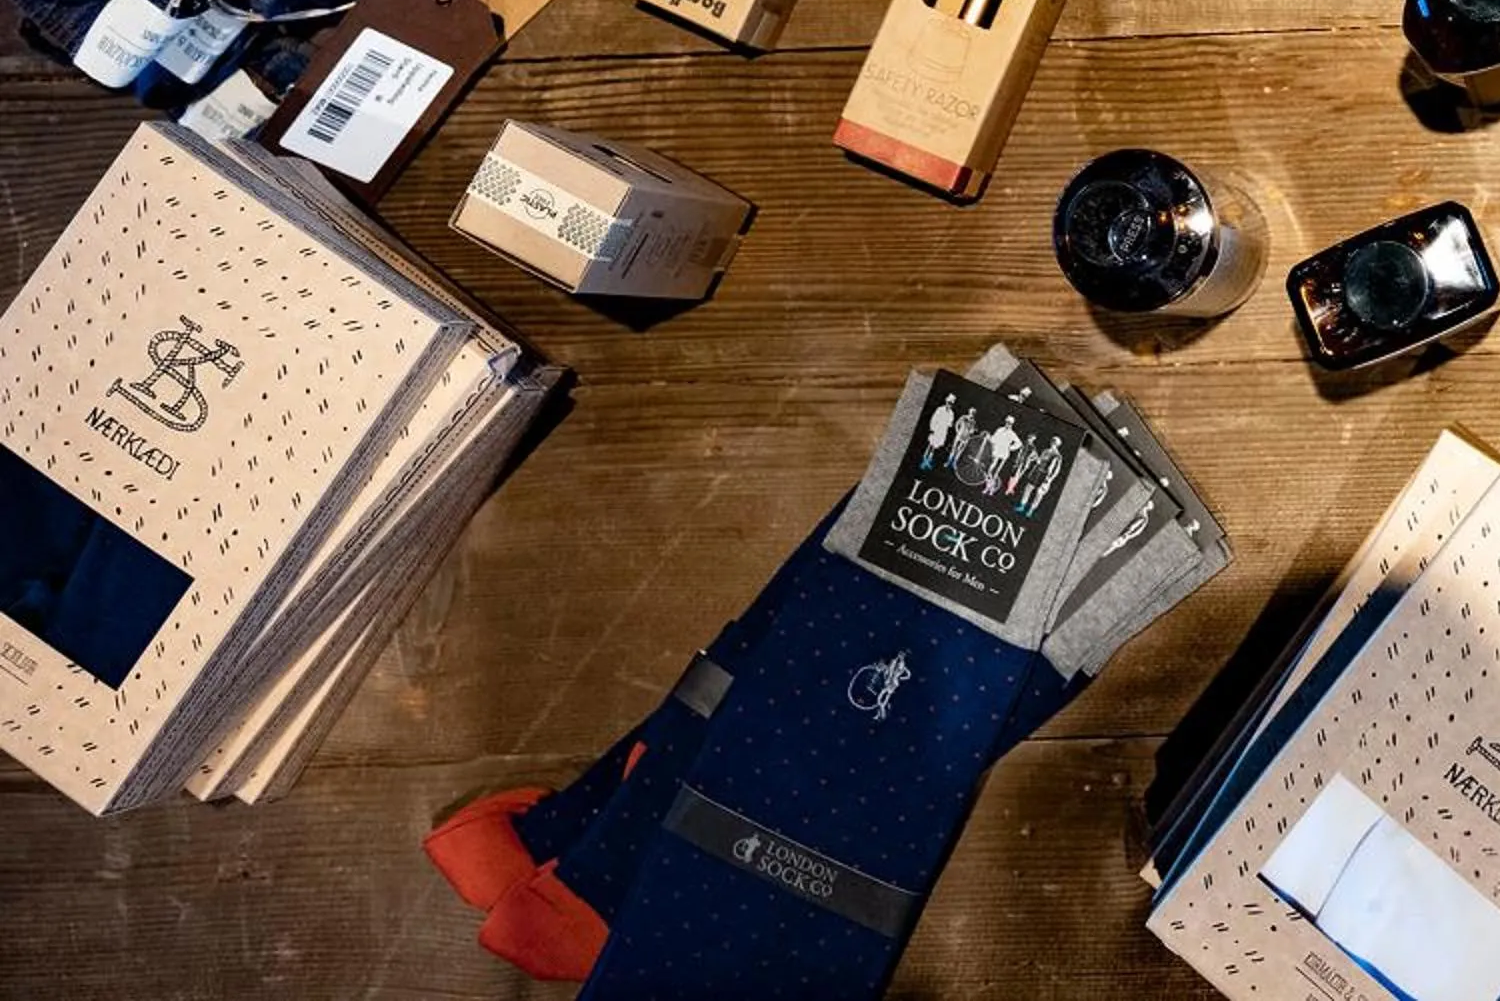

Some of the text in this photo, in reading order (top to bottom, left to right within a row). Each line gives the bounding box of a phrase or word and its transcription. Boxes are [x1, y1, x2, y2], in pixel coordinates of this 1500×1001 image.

[862, 62, 925, 98] SAFETY
[926, 89, 983, 122] RAZOR
[891, 506, 978, 562] SOCK
[906, 480, 1027, 548] LONDON
[897, 544, 947, 576] Accessories
[964, 573, 986, 593] Men
[755, 857, 810, 896] SOCK
[764, 839, 838, 884] LONDON
